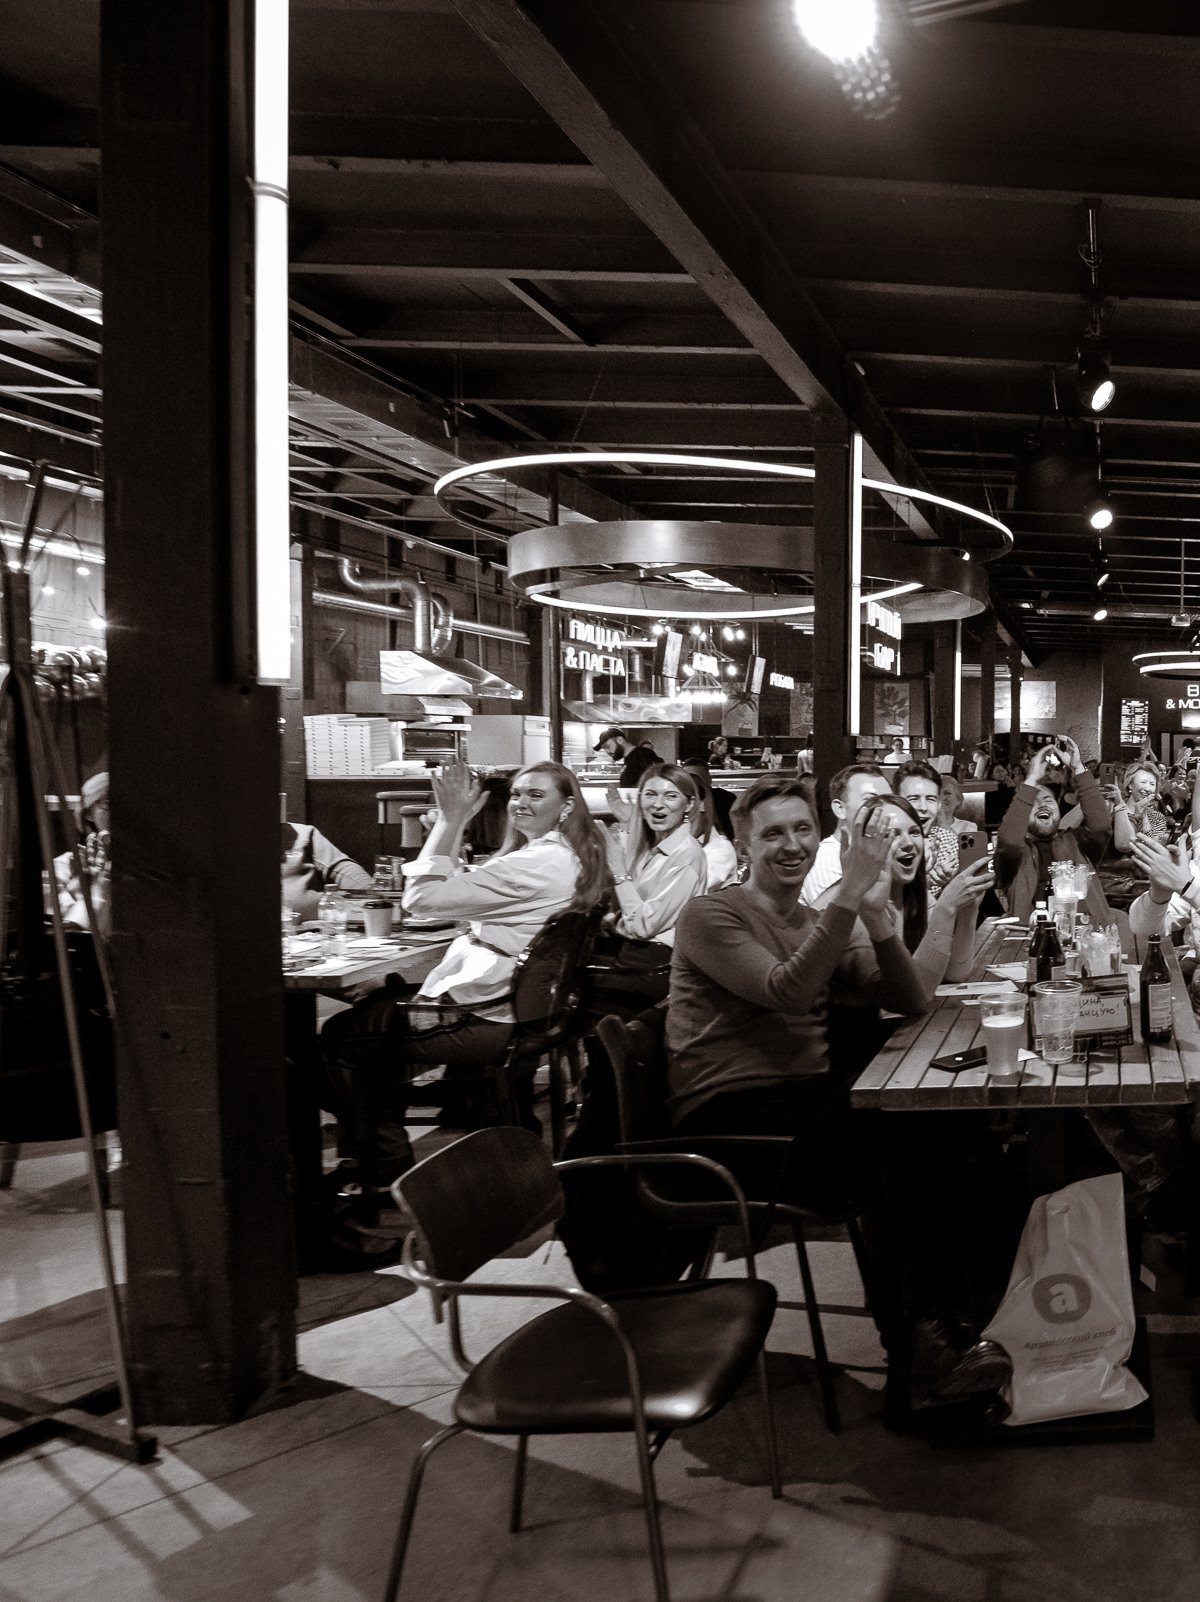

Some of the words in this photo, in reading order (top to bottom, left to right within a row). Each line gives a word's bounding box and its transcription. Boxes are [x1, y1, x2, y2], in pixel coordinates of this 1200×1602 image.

[569, 619, 622, 652] ПИЦЦА
[579, 650, 625, 676] ПАСТА
[1166, 699, 1176, 709] &
